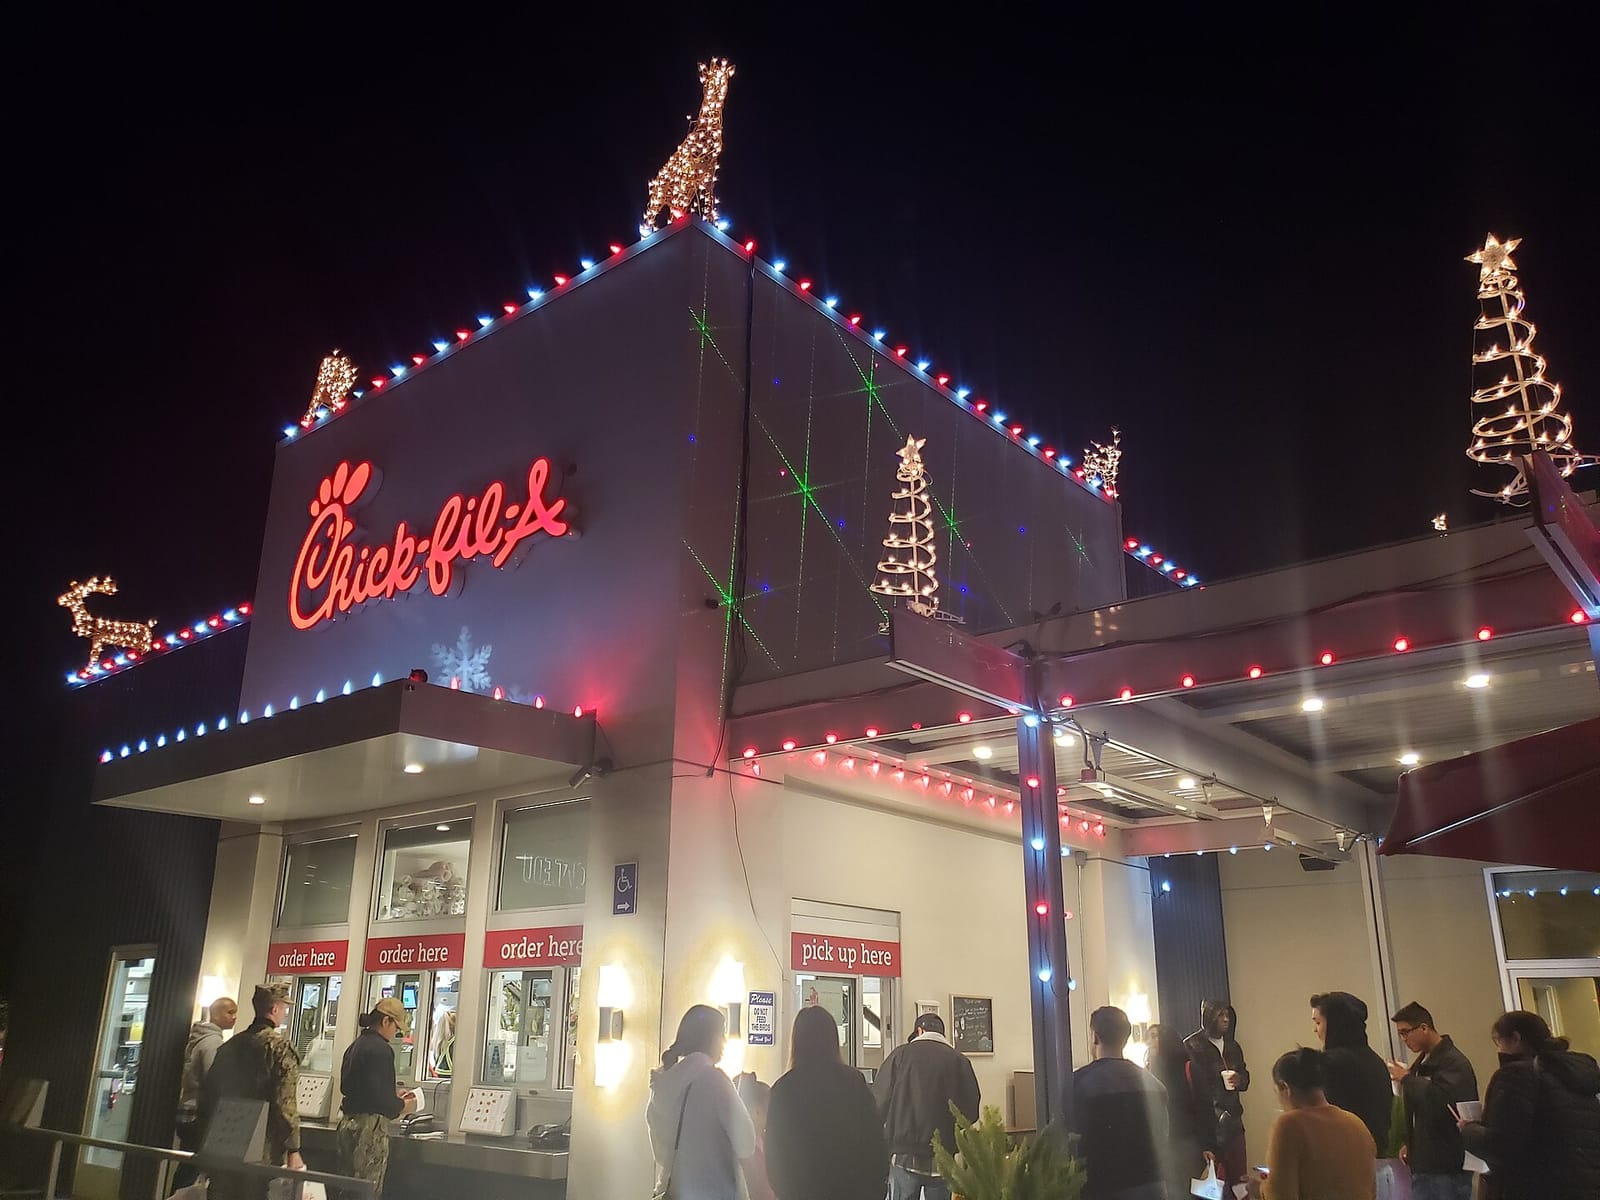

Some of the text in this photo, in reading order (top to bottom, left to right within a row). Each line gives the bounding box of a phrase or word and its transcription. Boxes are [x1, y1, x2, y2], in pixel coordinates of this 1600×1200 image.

[289, 457, 567, 630] Chick-fil-A
[278, 948, 336, 967] order here
[379, 943, 448, 965] order here
[501, 934, 583, 959] order here
[802, 938, 892, 969] pick up here
[751, 993, 772, 1004] Please
